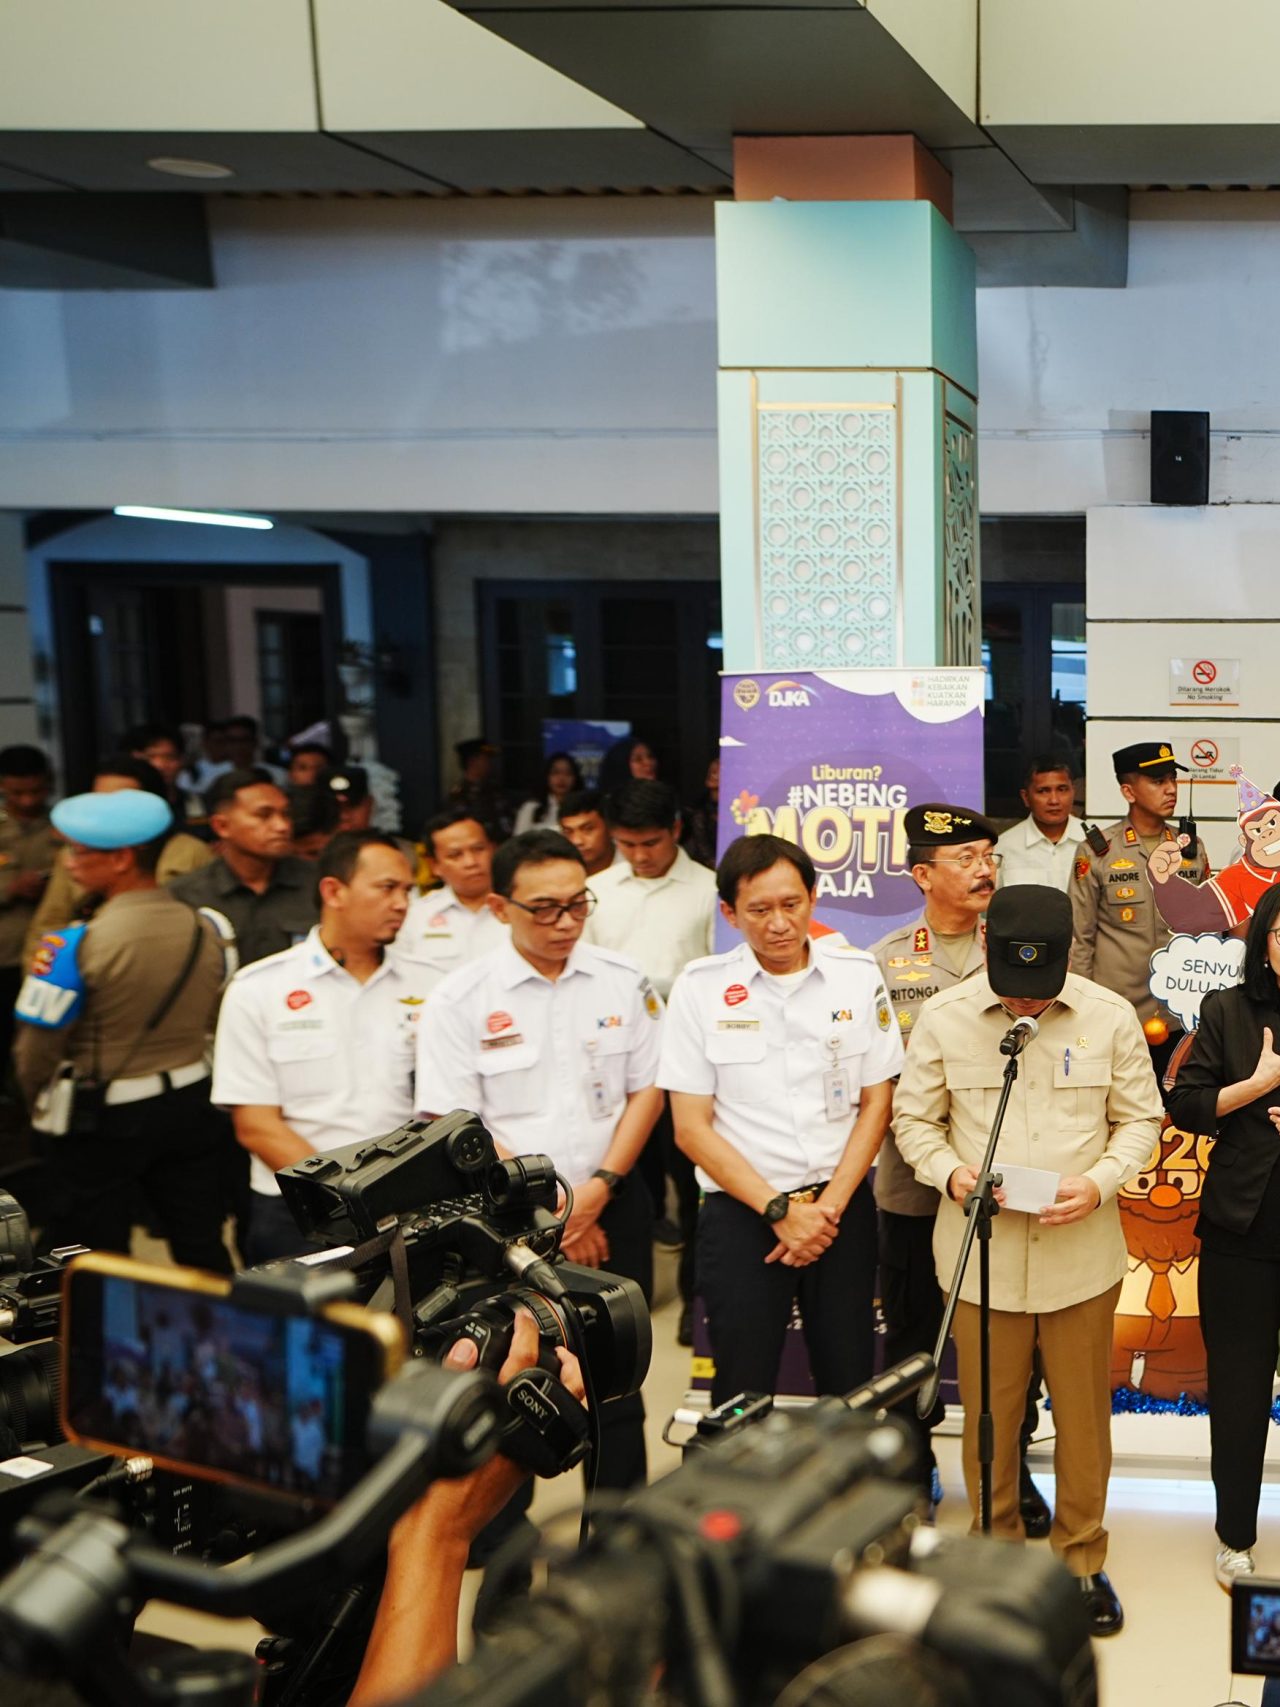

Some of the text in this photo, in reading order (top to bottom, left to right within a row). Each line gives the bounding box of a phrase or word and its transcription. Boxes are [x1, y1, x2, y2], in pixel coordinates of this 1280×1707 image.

[769, 690, 810, 706] DJKA
[812, 765, 882, 781] Liburan?
[787, 784, 907, 808] #NEBENG
[746, 806, 909, 873] MOTI
[1109, 872, 1139, 883] ANDRE
[1178, 870, 1197, 879] OLRI
[816, 873, 873, 898] AJA
[1166, 976, 1210, 993] DULU
[890, 986, 939, 1001] RITONGA
[517, 1390, 548, 1418] SONY
